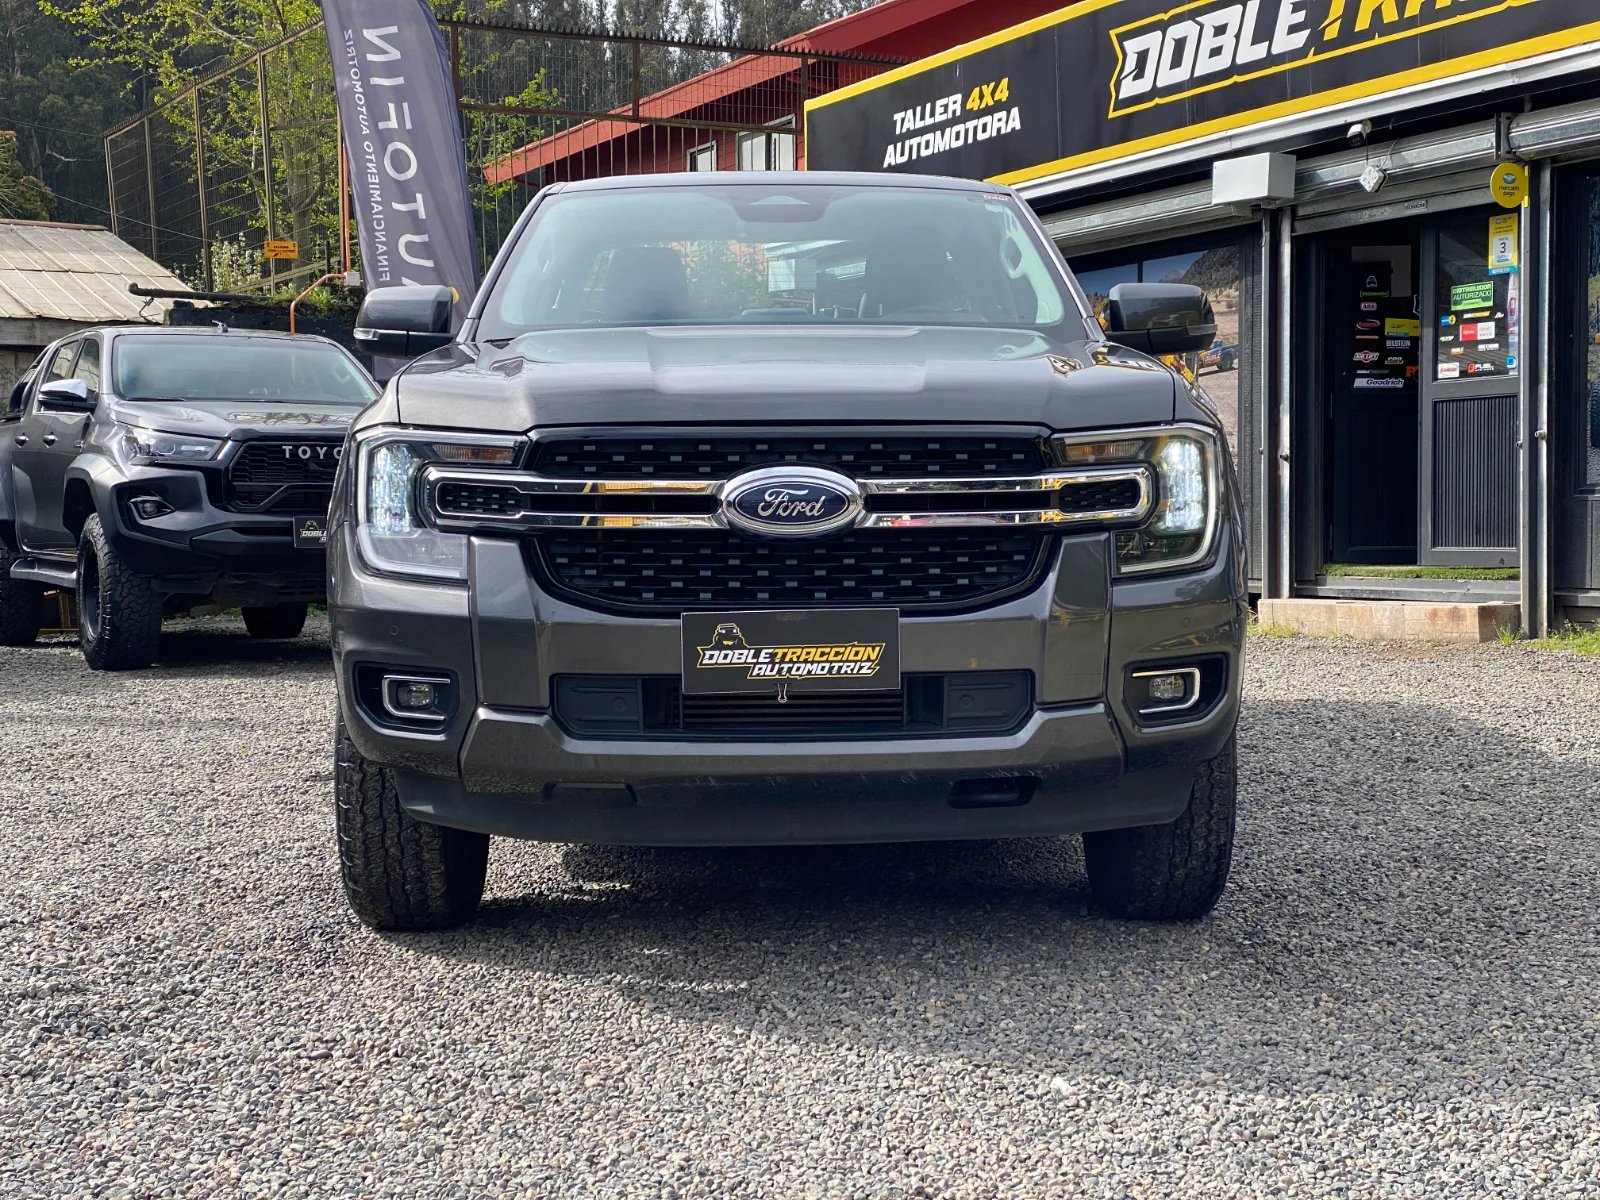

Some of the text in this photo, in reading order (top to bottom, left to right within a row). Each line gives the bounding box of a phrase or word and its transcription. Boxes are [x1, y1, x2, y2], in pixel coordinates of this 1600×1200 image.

[893, 77, 1009, 134] TALLER 4X4
[883, 106, 1021, 168] AUTOMOTORA
[1499, 242, 1506, 253] 3
[1453, 290, 1491, 300] AUTORIZADO
[757, 488, 826, 517] Ford
[752, 661, 874, 676] AUTOMOTRIZ
